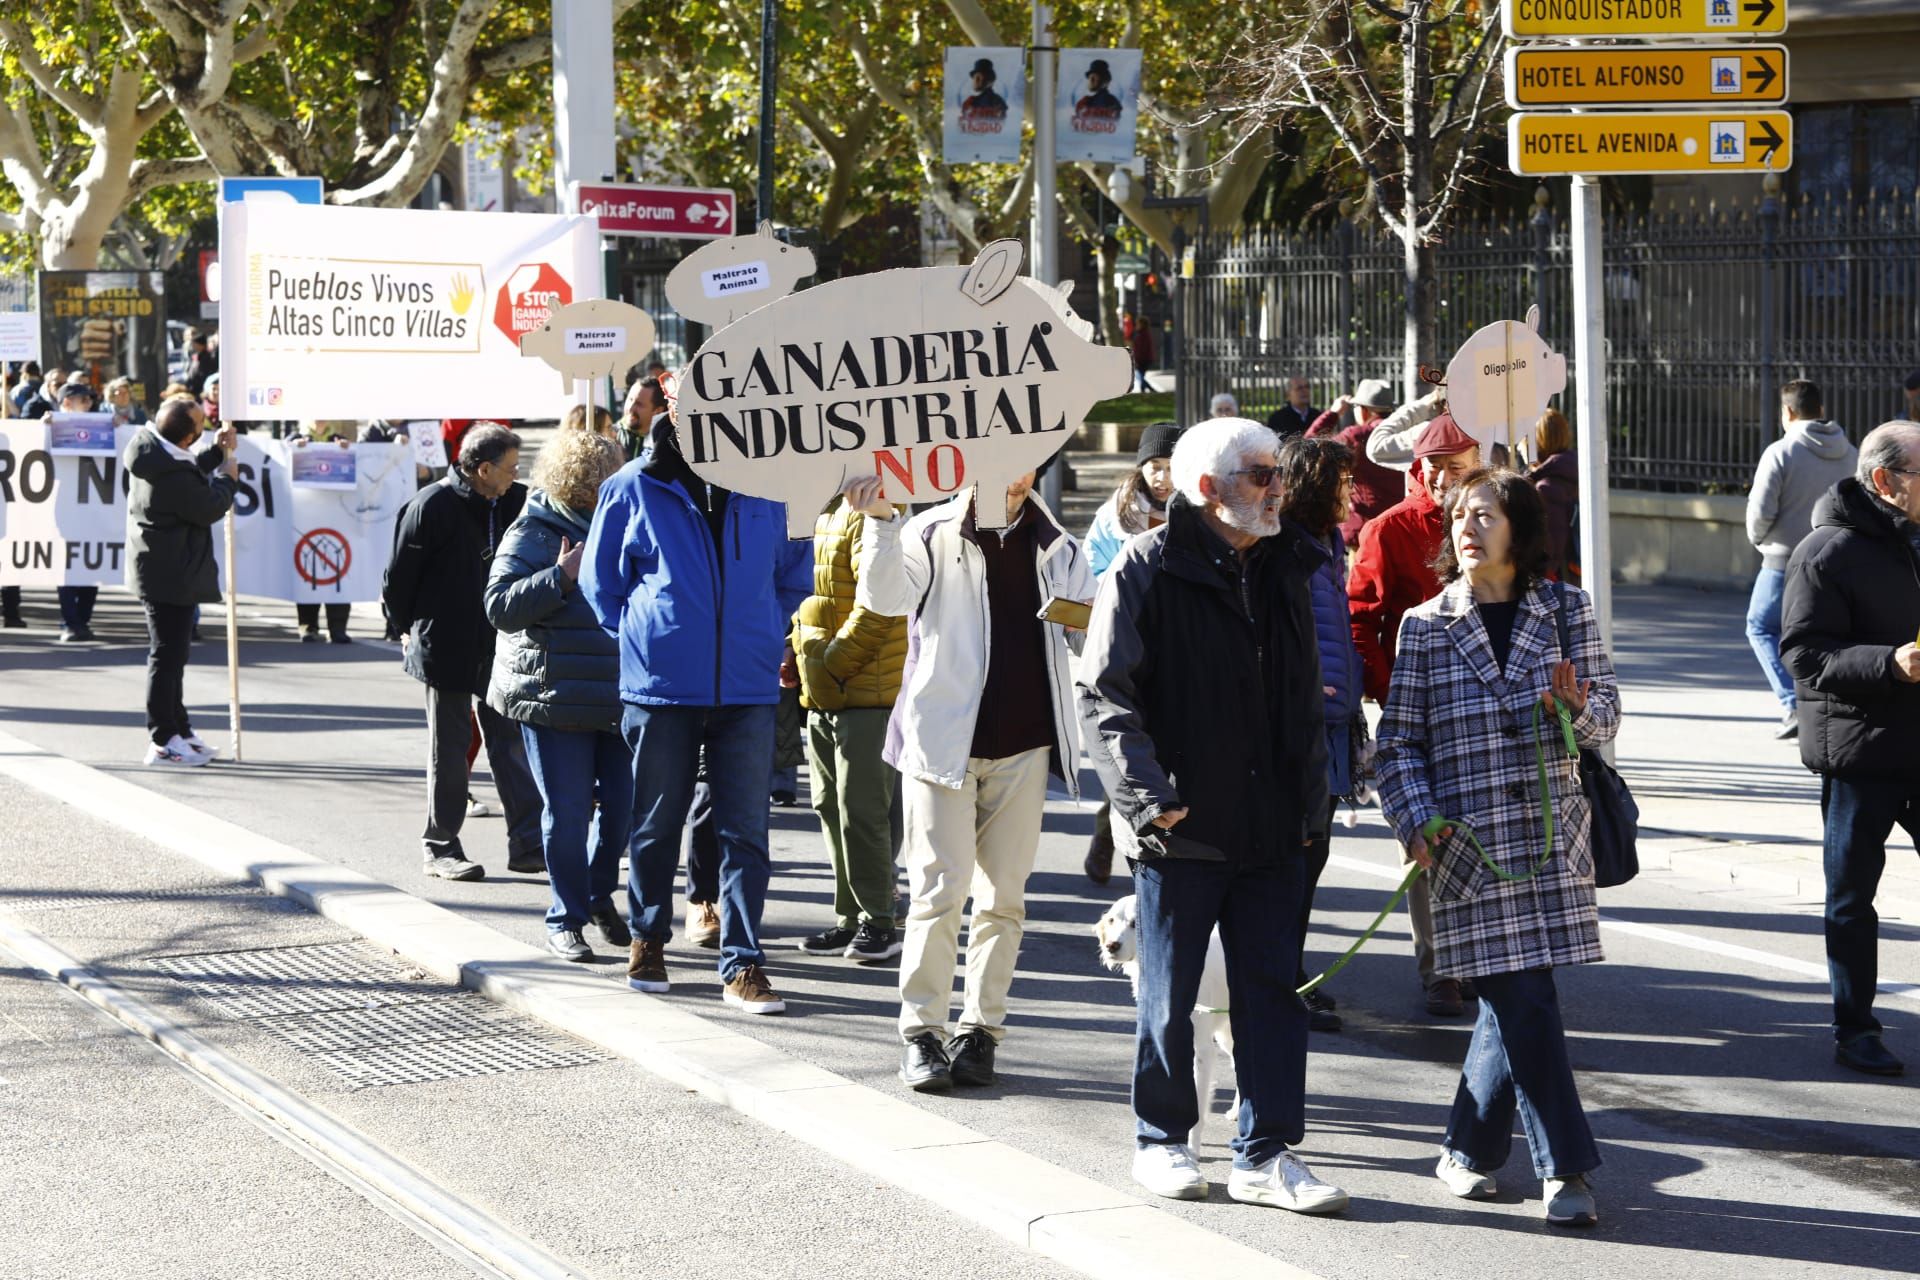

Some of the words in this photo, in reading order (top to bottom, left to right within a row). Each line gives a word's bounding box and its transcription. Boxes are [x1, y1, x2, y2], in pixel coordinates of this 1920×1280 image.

[1519, 0, 1682, 20] CONQUISTADOR
[1522, 67, 1586, 87] HOTEL
[1595, 65, 1684, 86] ALFONSO
[1524, 134, 1588, 154] HOTEL
[1597, 133, 1678, 153] AVENIDA
[712, 267, 759, 281] Maltrato
[719, 277, 758, 291] Animal
[268, 269, 363, 301] Pueblos
[371, 273, 434, 303] Vivos
[268, 305, 323, 336] Altas
[332, 306, 395, 337] Cinco
[406, 309, 467, 338] Villas
[516, 307, 552, 319] GANAD
[578, 341, 613, 349] Animal
[687, 384, 1066, 464] INDUSTRIAL
[77, 456, 131, 504] N
[872, 444, 965, 500] NO
[12, 541, 52, 569] UN
